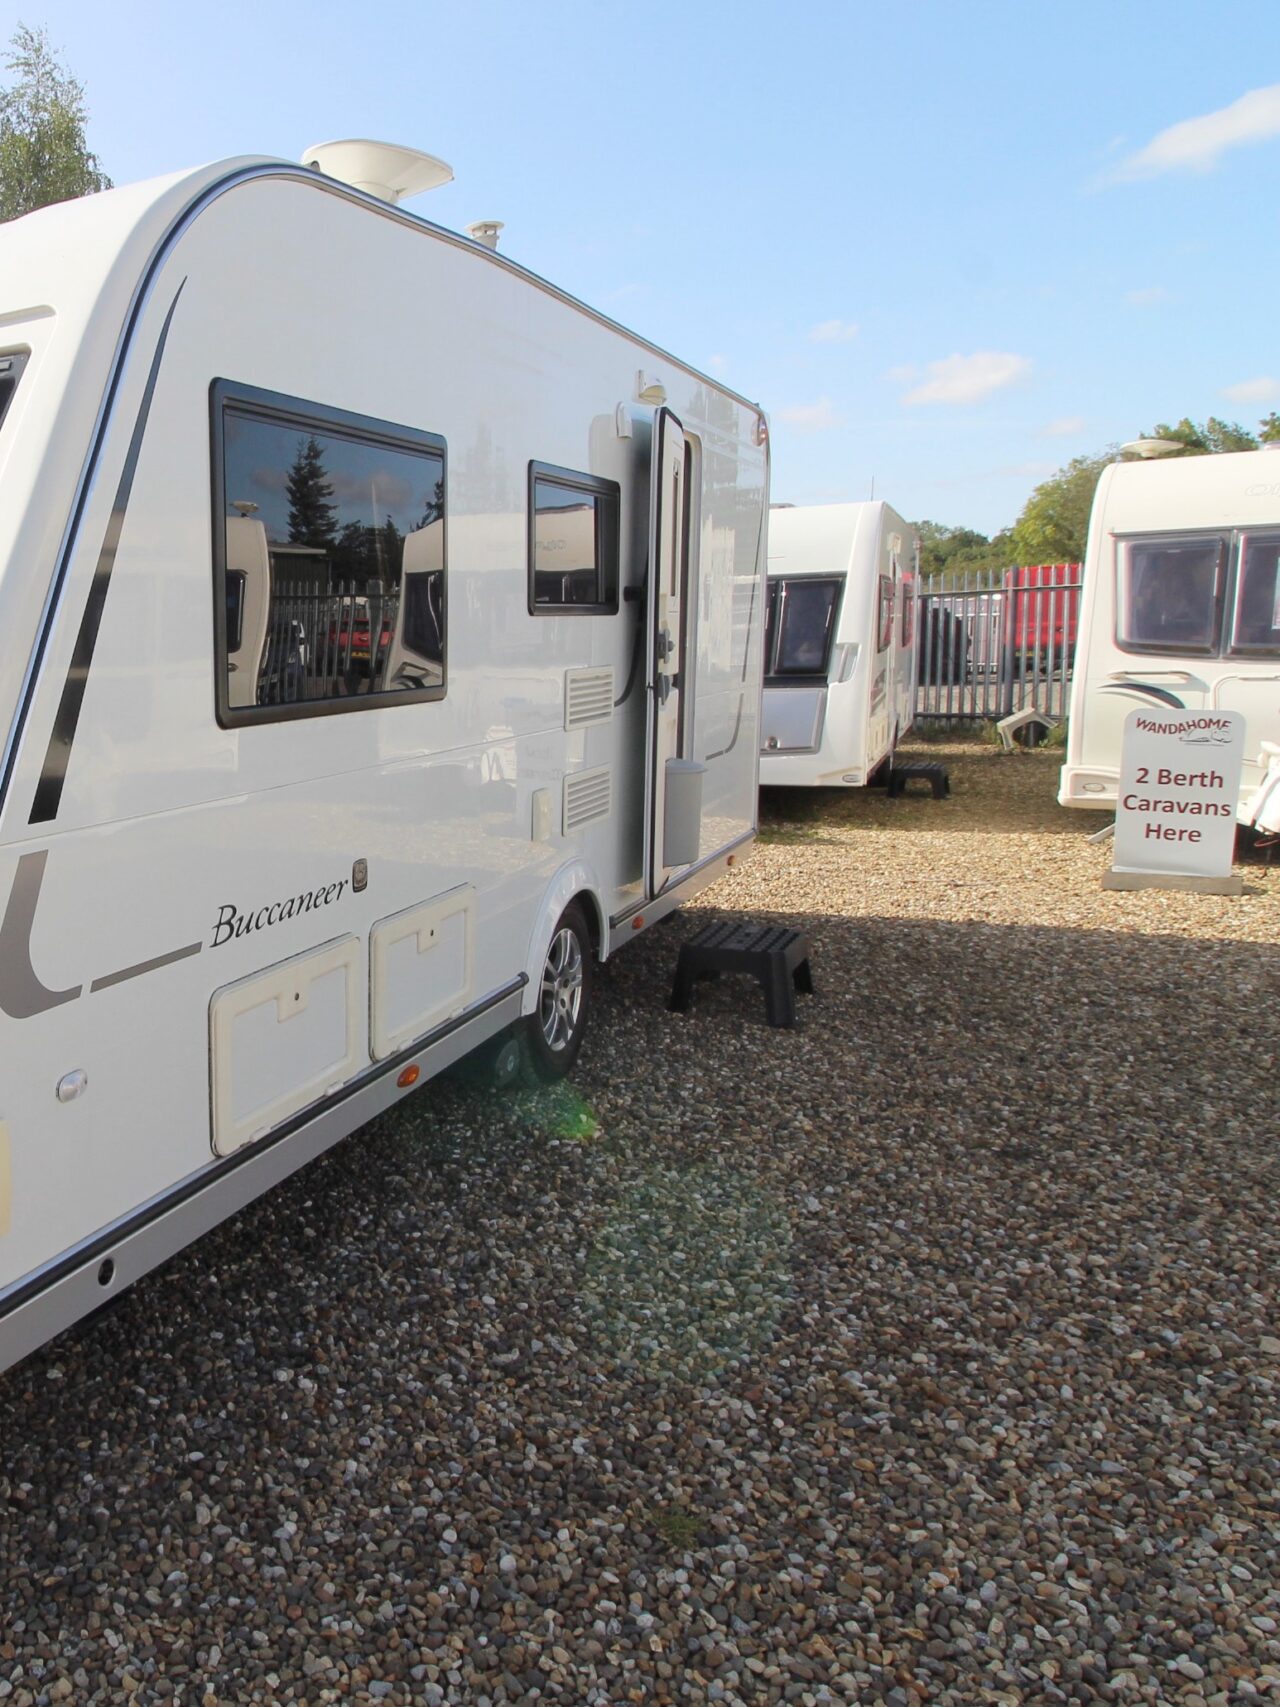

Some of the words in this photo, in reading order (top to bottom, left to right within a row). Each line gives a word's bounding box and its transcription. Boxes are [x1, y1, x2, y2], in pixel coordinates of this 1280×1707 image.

[1136, 717, 1232, 735] WANDAHOME
[1136, 767, 1149, 784] 2
[1157, 768, 1224, 788] Berth
[1123, 794, 1232, 817] Caravans
[1144, 823, 1202, 842] Here
[209, 879, 349, 948] Buccaneer
